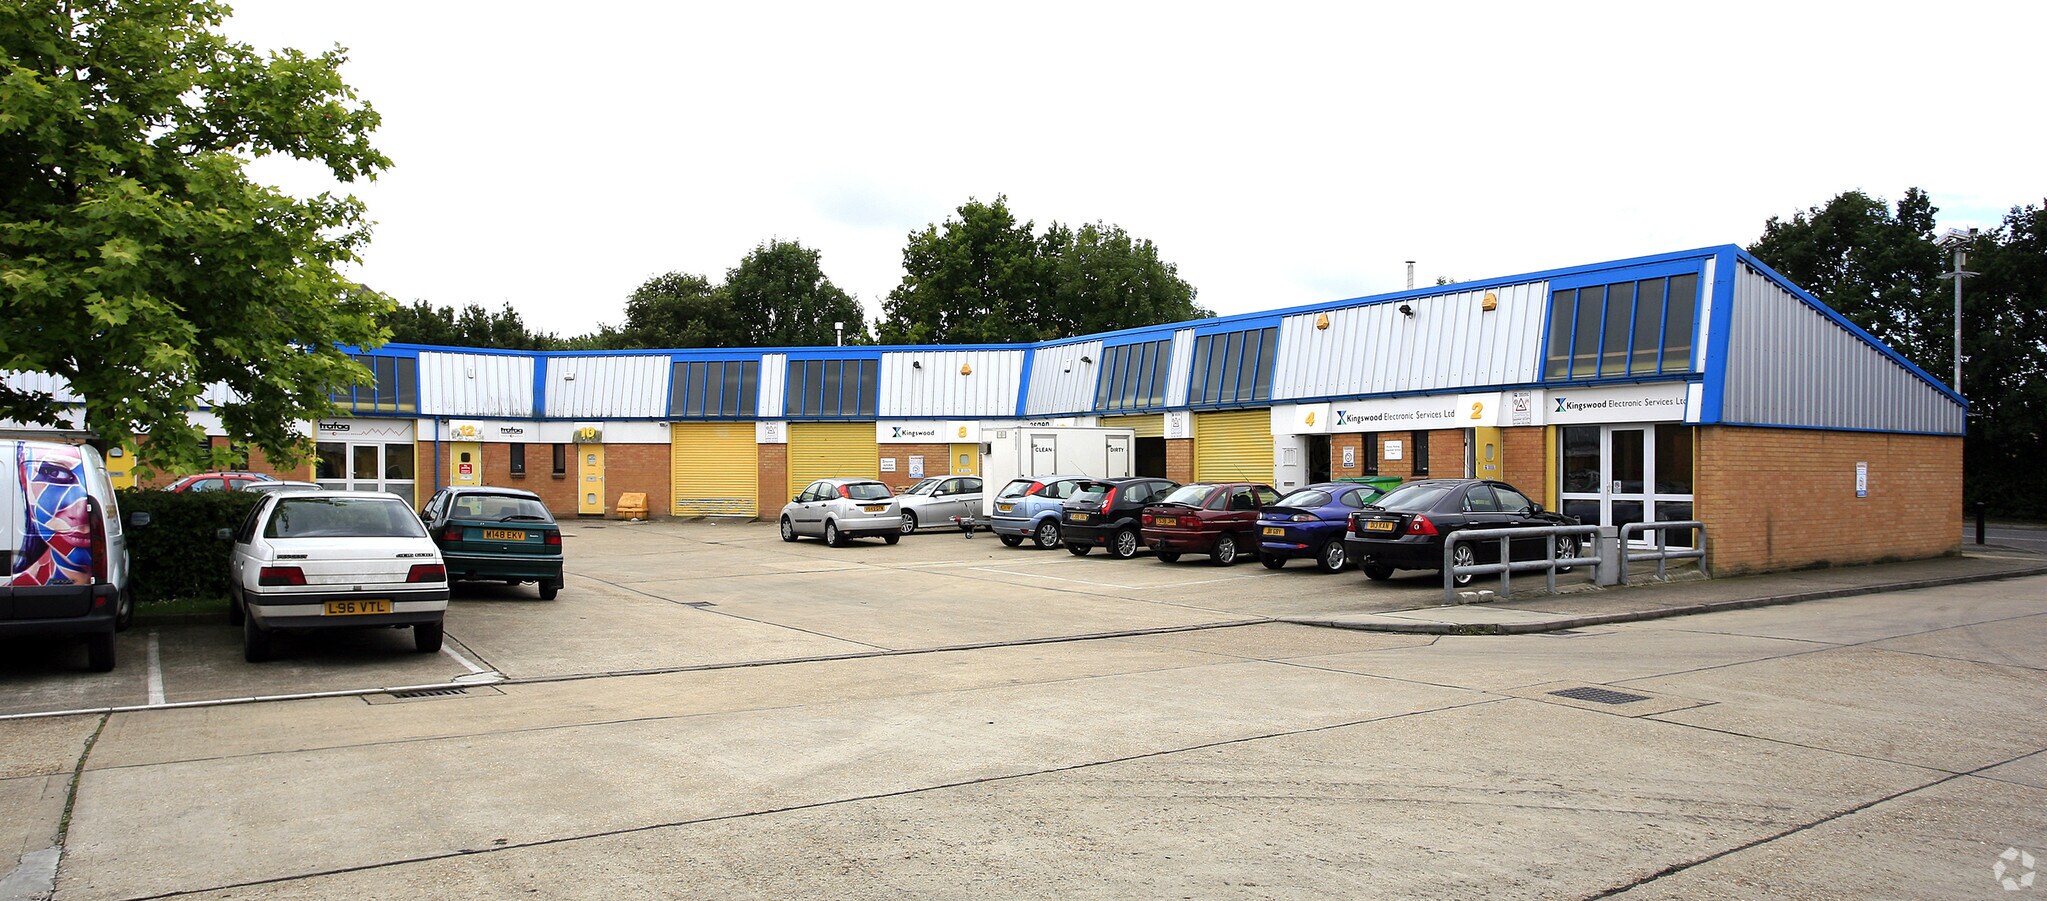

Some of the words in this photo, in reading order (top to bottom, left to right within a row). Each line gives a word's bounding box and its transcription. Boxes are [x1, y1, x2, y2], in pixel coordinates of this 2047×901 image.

[1470, 402, 1483, 419] 2
[1566, 400, 1606, 411] Kingswood
[1608, 400, 1642, 408] Electronic
[1644, 398, 1673, 407] Services
[1305, 411, 1315, 427] 4
[1346, 413, 1383, 425] Kingswood
[1384, 410, 1414, 421] Electronic
[1416, 410, 1442, 419] Services
[1443, 409, 1455, 418] Ltd
[459, 424, 475, 437] 12
[580, 426, 596, 439] 10
[901, 429, 935, 438] Kingswood
[958, 426, 967, 438] 8
[486, 530, 505, 539] M148
[507, 531, 523, 539] EKV
[328, 602, 355, 614] L96
[360, 602, 385, 613] VTL
